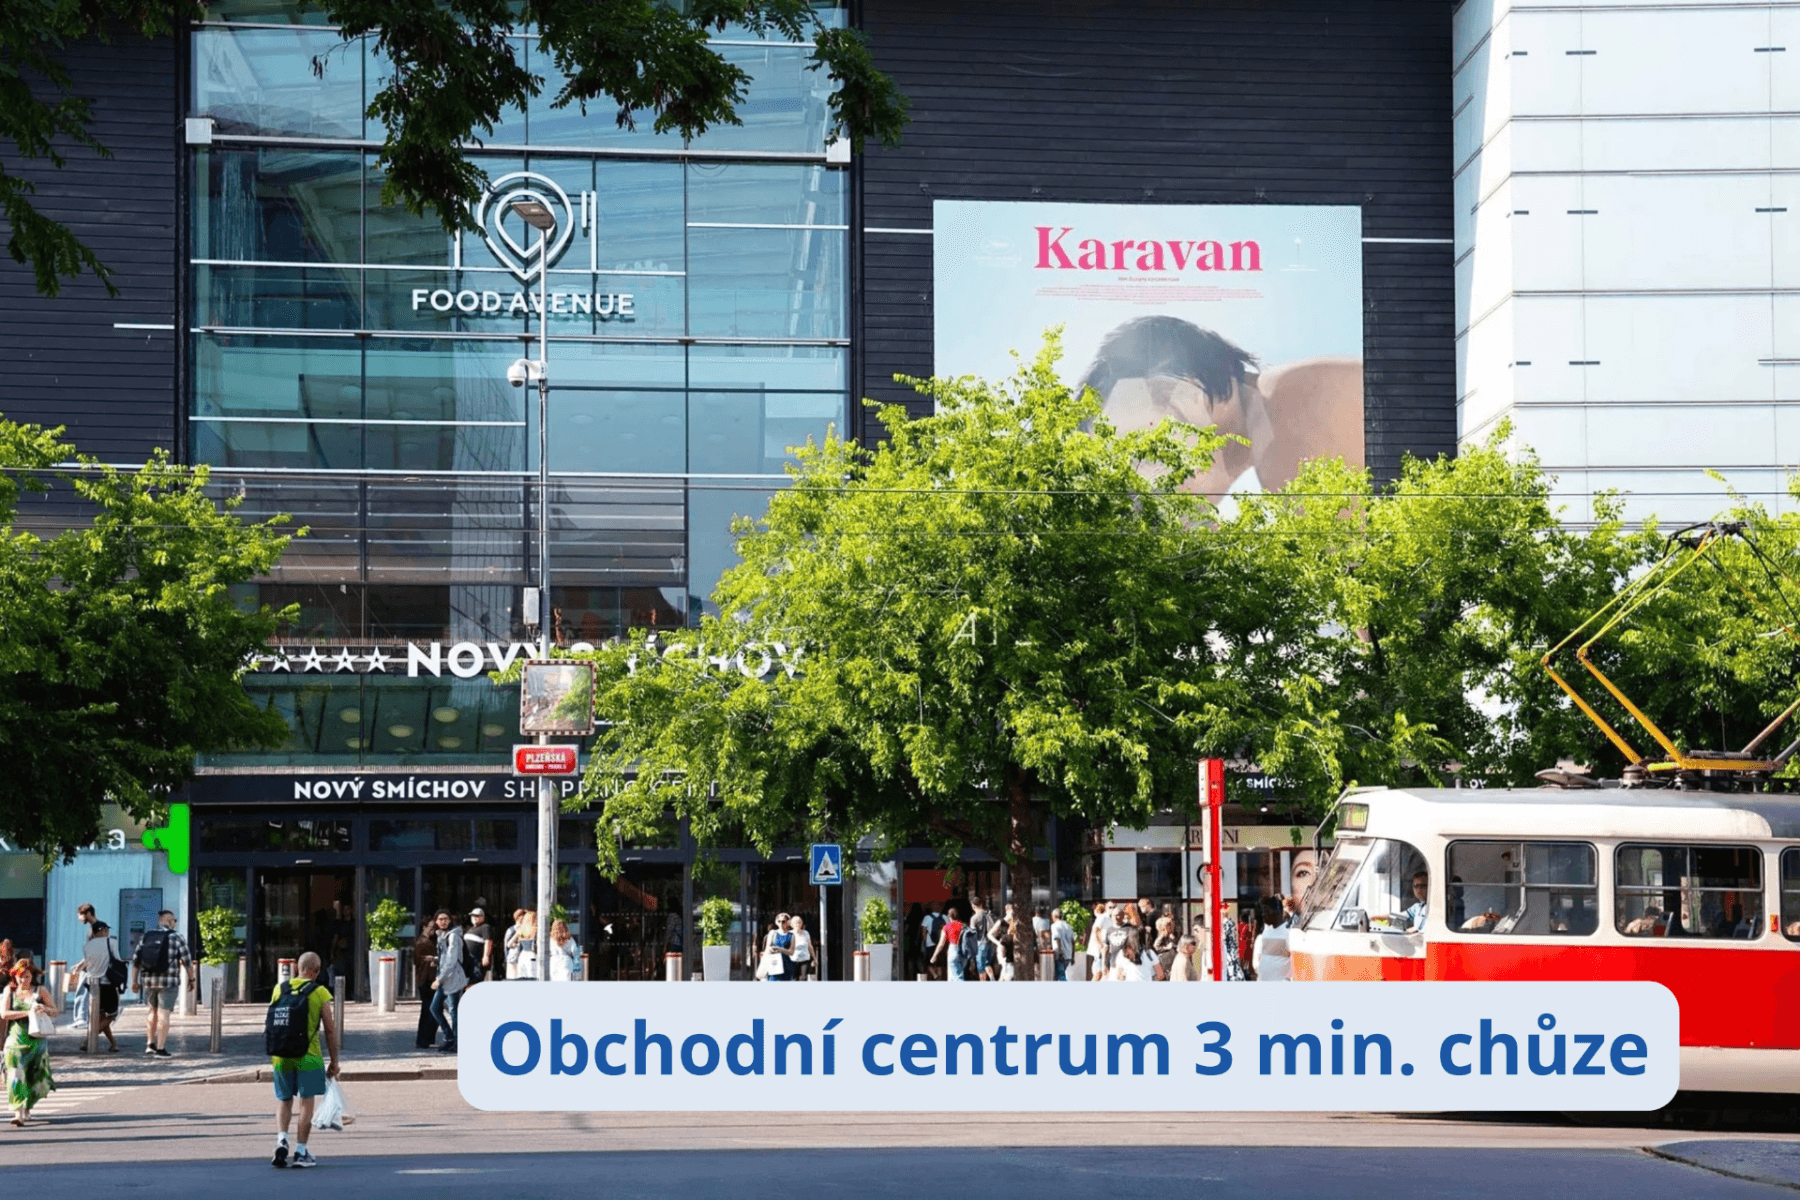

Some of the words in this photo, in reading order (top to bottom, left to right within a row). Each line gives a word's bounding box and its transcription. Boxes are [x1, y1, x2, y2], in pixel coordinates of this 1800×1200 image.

[1034, 225, 1263, 272] Karavan
[412, 289, 501, 312] FOOD
[509, 292, 635, 315] AVENUE
[294, 776, 366, 800] NOVÝ
[371, 776, 487, 799] SMÍCHOV
